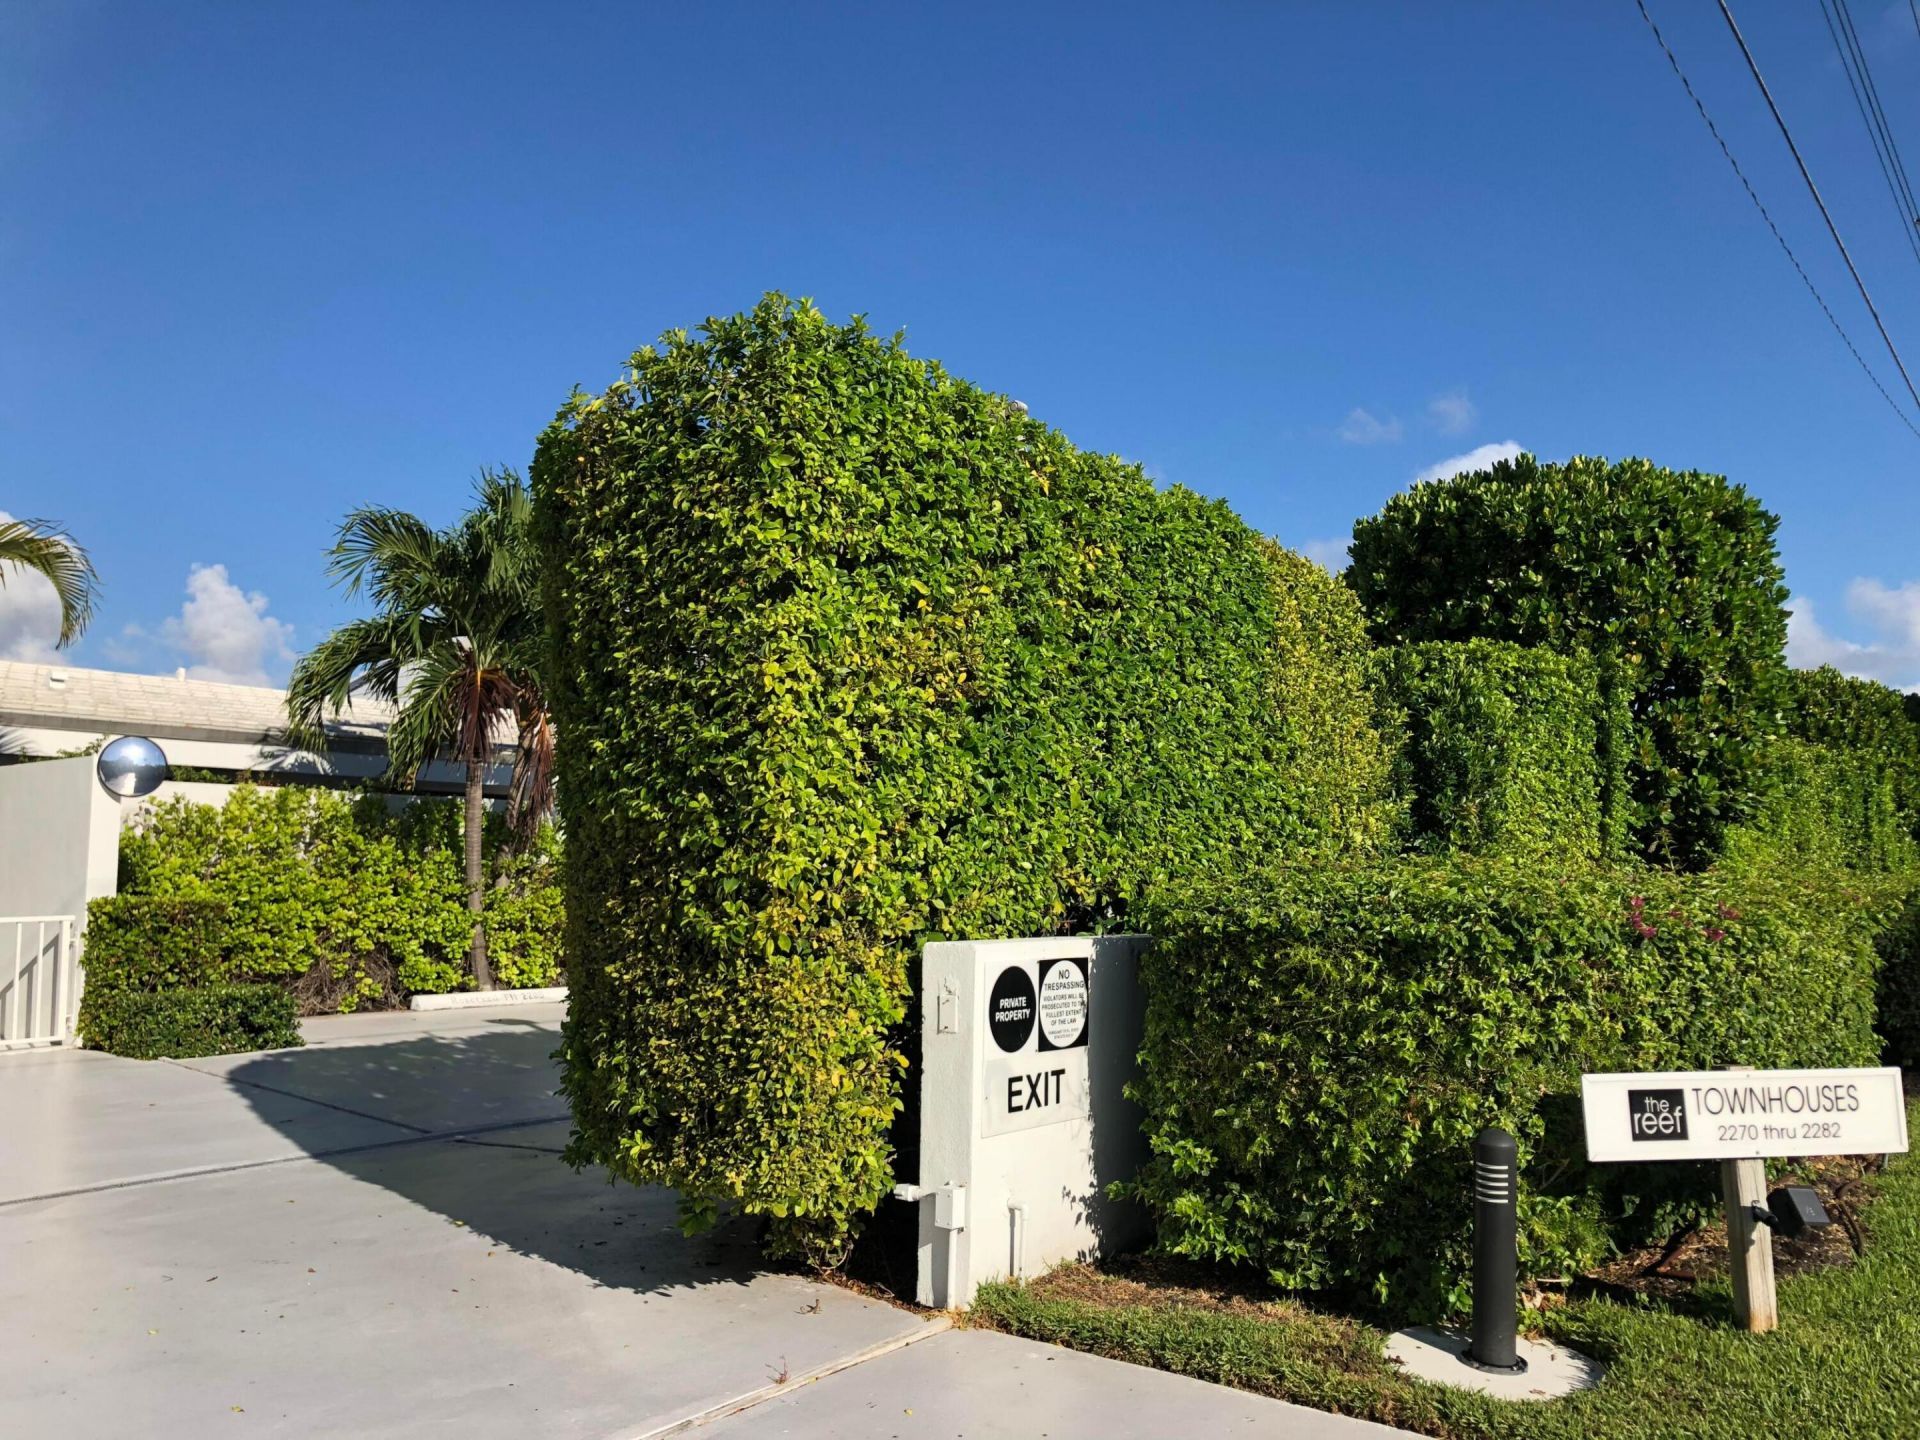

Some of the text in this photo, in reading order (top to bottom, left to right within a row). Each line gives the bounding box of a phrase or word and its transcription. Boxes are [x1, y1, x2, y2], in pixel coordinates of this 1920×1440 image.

[1058, 969, 1070, 979] NO
[1044, 981, 1084, 991] TRESPASSING
[1000, 996, 1027, 1009] PRIVATE
[1043, 994, 1067, 1002] VIOLATORS
[1041, 1002, 1070, 1010] PROSECUTED
[995, 1009, 1030, 1022] PROPERTY
[1066, 1009, 1082, 1017] EXTENT
[1008, 1068, 1066, 1113] EXIT
[1644, 1096, 1670, 1113] the
[1692, 1084, 1860, 1115] TOWNHOUSES
[1633, 1106, 1683, 1134] reef
[1718, 1122, 1842, 1141] 2270 thru 2282
